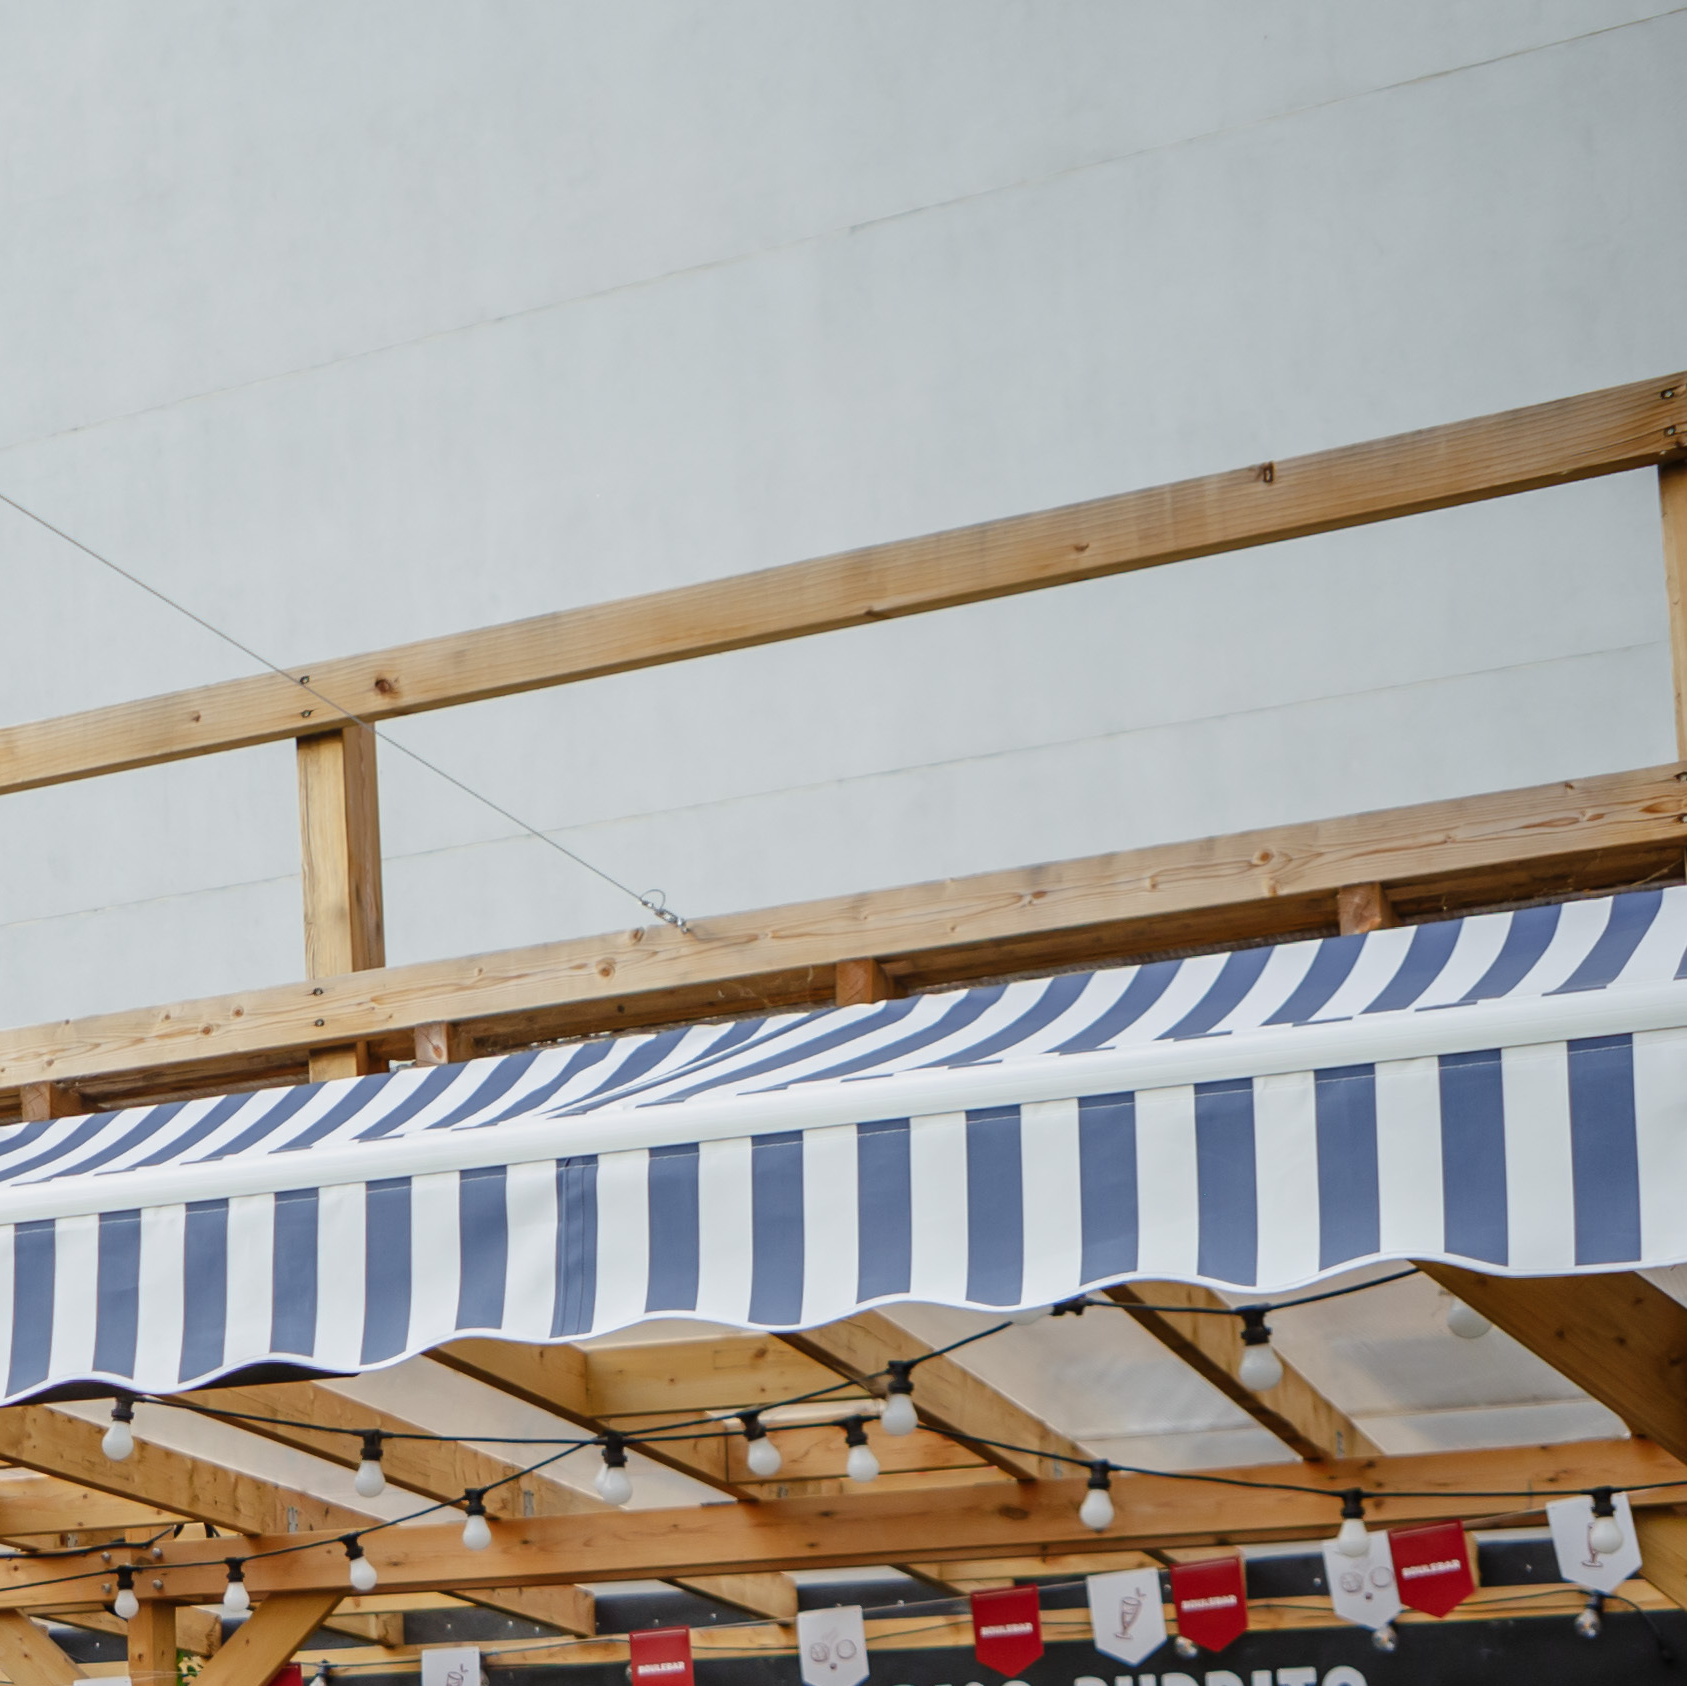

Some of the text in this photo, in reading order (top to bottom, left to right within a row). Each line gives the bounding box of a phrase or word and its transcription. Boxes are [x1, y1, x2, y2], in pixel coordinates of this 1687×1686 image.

[1402, 1560, 1462, 1579] BOULEBAR
[981, 1623, 1033, 1637] BOULEBAR
[638, 1662, 685, 1675] BOULEBAR
